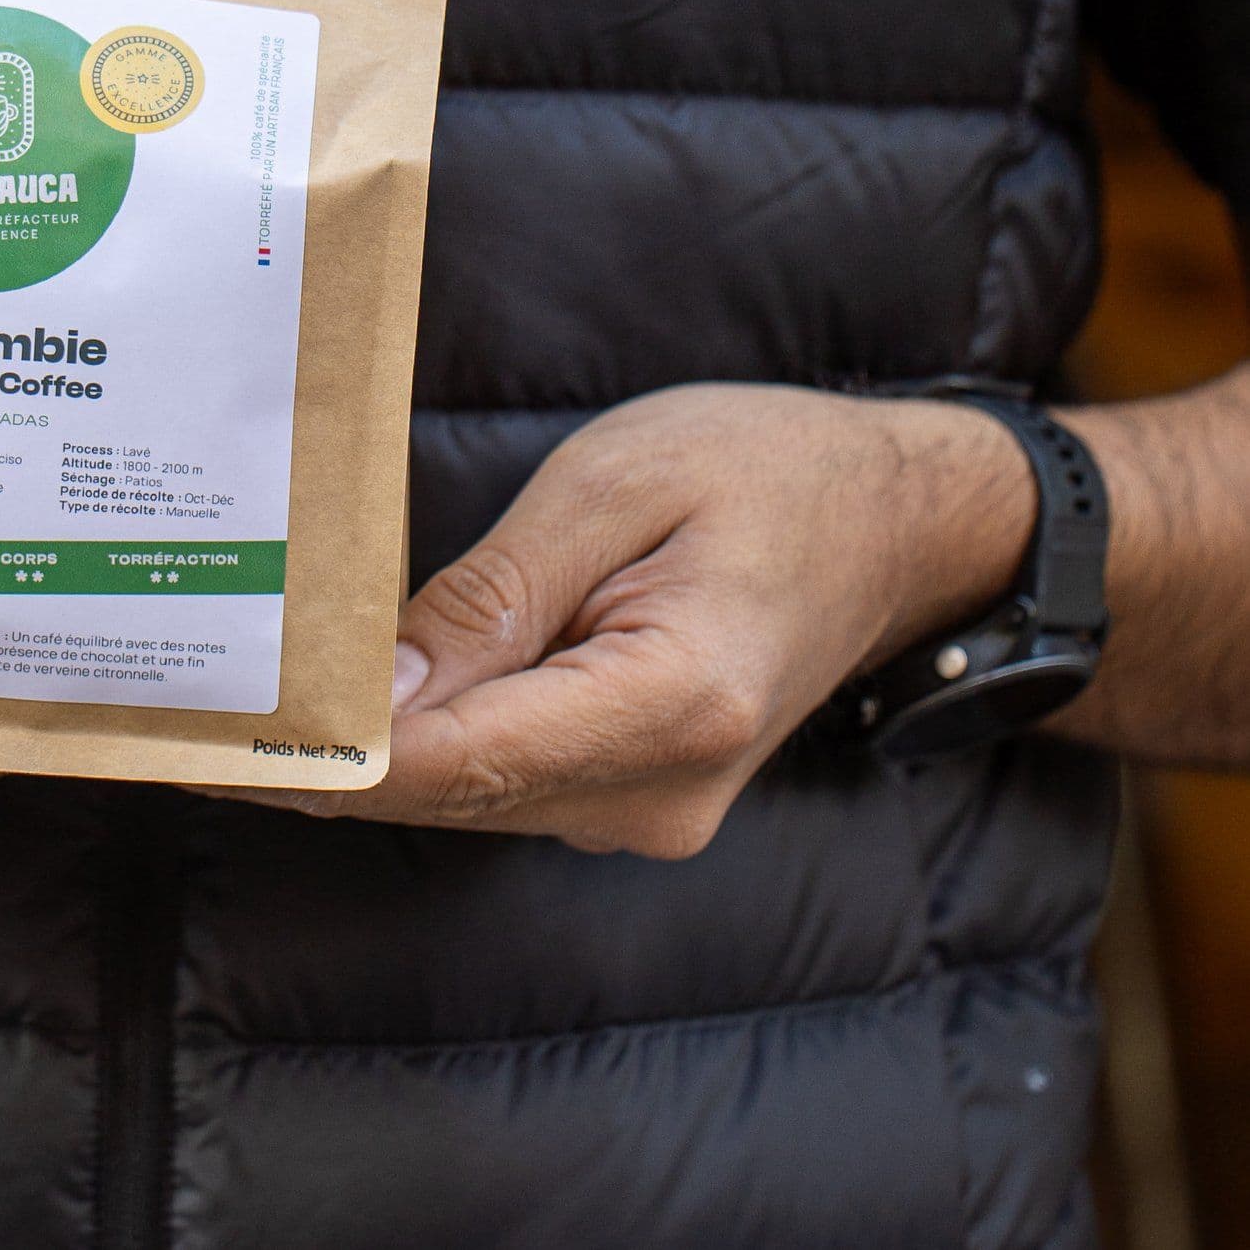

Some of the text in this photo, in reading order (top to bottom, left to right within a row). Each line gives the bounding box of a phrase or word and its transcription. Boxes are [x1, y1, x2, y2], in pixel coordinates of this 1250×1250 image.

[115, 47, 167, 62] GAMME
[107, 79, 181, 112] EXCELLENCE
[257, 88, 266, 102] de
[255, 105, 265, 129] café
[250, 131, 262, 160] 100%
[258, 37, 285, 245] TORRÉFIÉ PAR UN ARTISAN FRANÇAIS
[62, 442, 113, 455] Process
[123, 446, 151, 457] Lavé
[62, 457, 112, 470] Altitude
[123, 461, 150, 472] 1800
[161, 463, 189, 475] 2100
[192, 467, 203, 475] m
[61, 472, 115, 487] Séchage
[125, 476, 163, 487] Patios
[60, 486, 108, 499] Période
[111, 489, 126, 500] de
[129, 490, 174, 503] récolte
[59, 500, 90, 513] Type
[93, 502, 108, 512] de
[111, 503, 156, 515] récolte
[166, 507, 220, 519] Manuelle
[0, 553, 58, 565] CORPS
[108, 551, 239, 566] TORRÉFACTION
[12, 632, 30, 643] Un
[33, 633, 62, 645] café
[65, 635, 123, 649] équilibré
[126, 640, 157, 650] avec
[160, 640, 185, 652] des
[187, 642, 226, 654] notes
[60, 649, 78, 661] de
[80, 651, 138, 664] chocolat
[141, 654, 156, 665] et
[159, 657, 184, 667] une
[187, 656, 205, 668] fin
[14, 661, 31, 673] de
[34, 665, 90, 677] verveine
[93, 666, 168, 682] citronnelle.
[253, 739, 367, 766] Poids Net 250g
